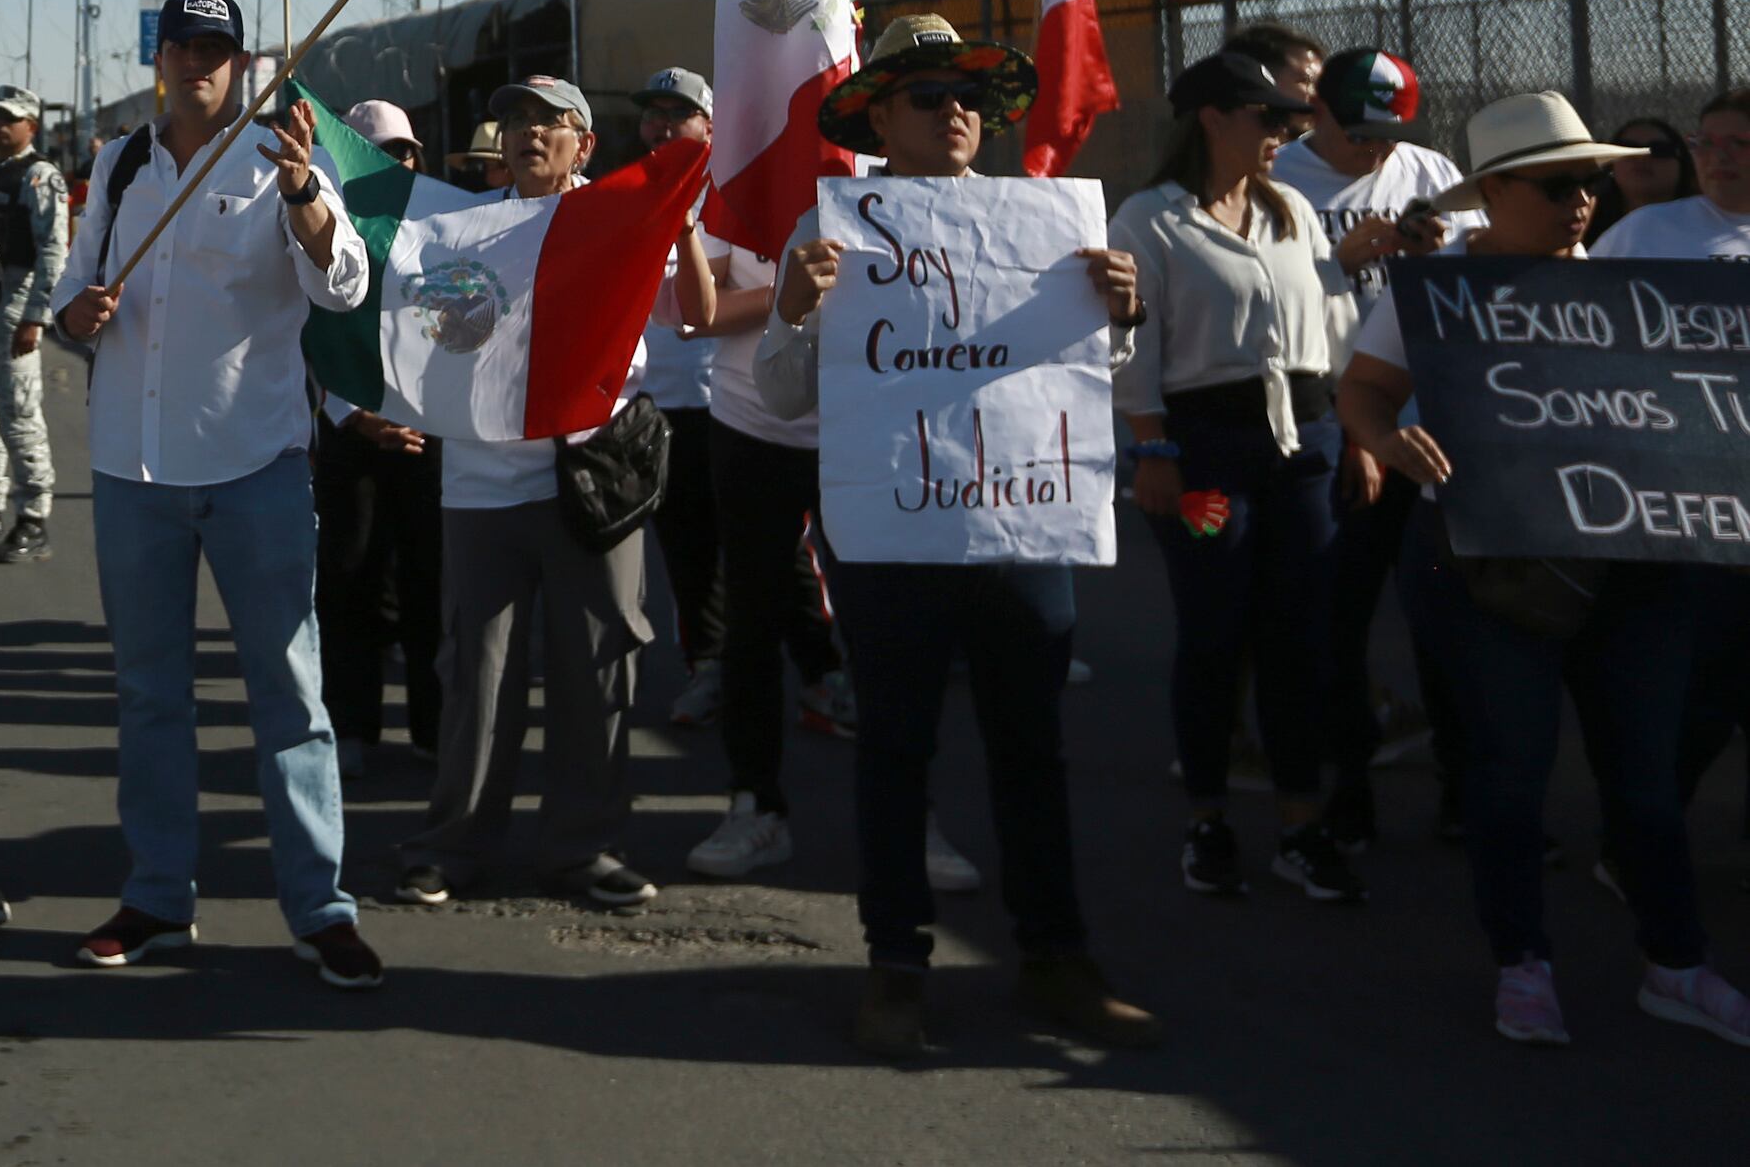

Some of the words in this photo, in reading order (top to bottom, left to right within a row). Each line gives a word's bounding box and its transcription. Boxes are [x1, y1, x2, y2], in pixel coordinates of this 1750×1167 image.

[858, 192, 960, 330] Soy
[1486, 361, 1678, 429] SOMOS
[895, 408, 1072, 513] Judicial
